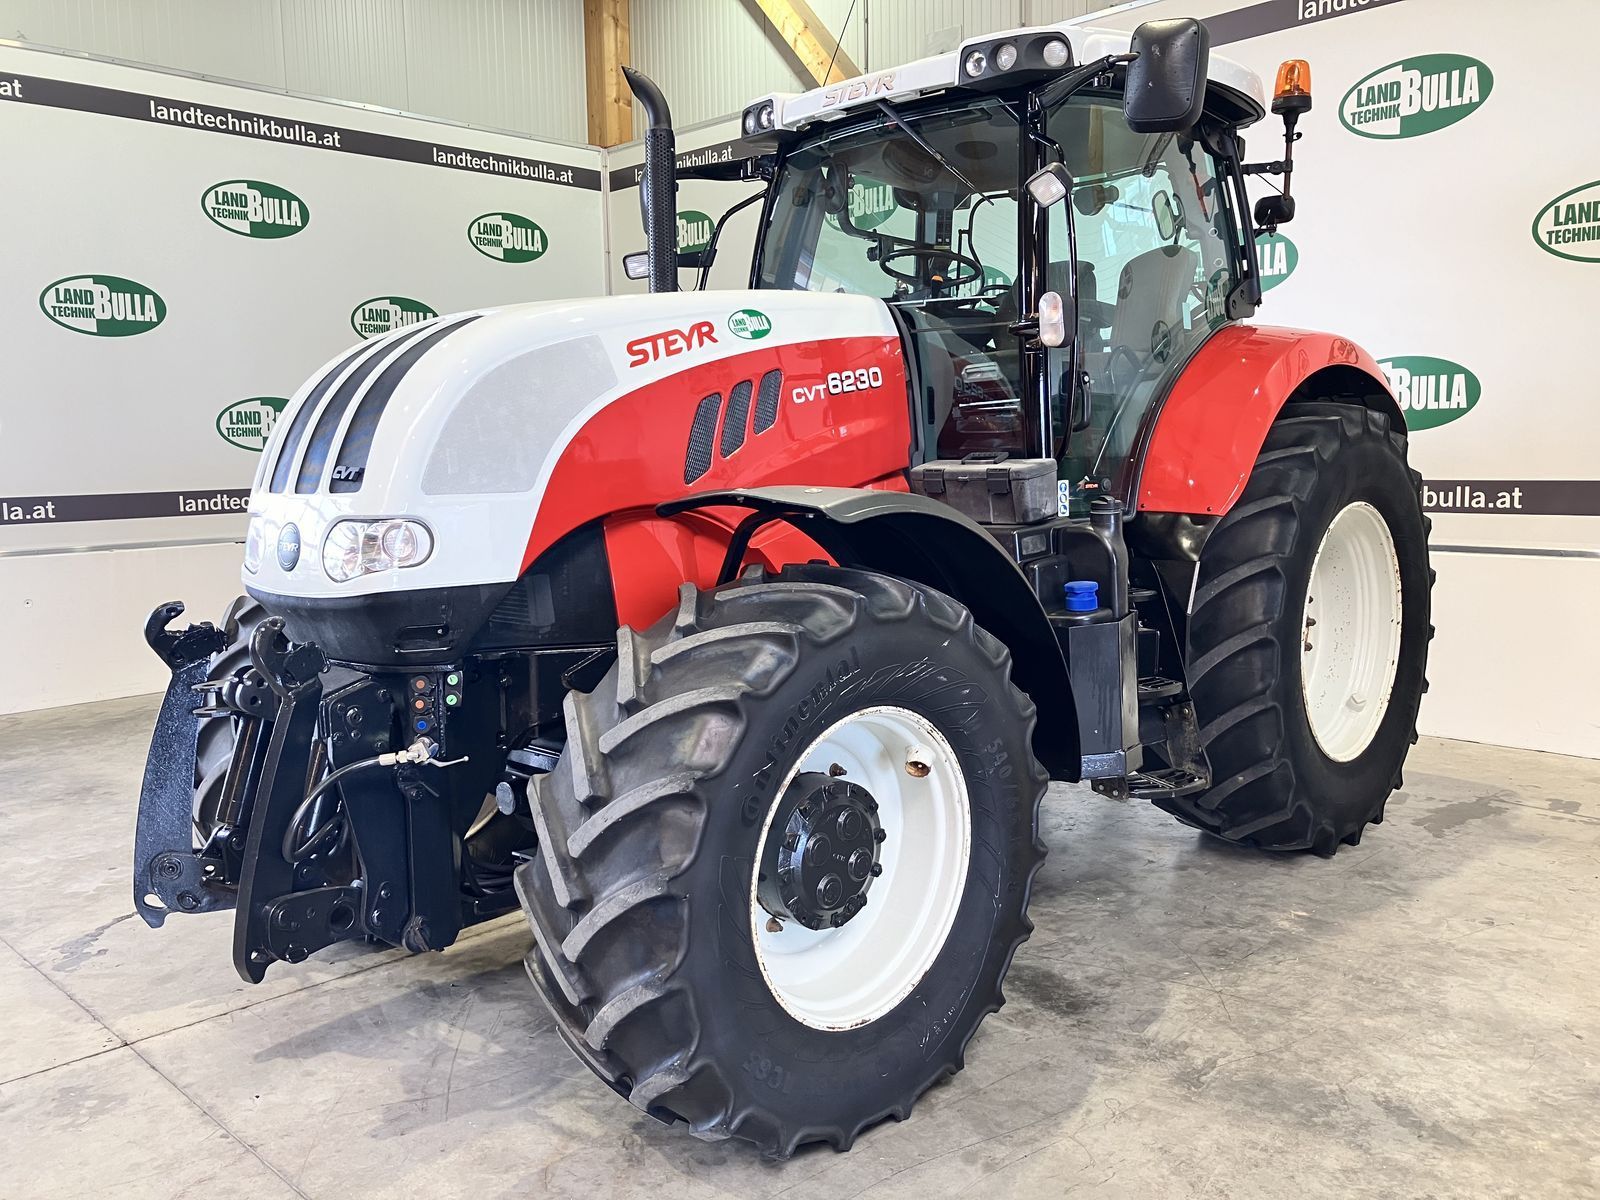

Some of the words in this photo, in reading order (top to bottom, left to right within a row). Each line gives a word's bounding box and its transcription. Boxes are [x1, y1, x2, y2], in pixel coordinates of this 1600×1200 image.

[823, 72, 896, 107] STEYR
[1356, 80, 1401, 108] LAND
[1400, 66, 1480, 117] BULLA
[150, 100, 341, 148] landtechnikbulla.at
[1350, 103, 1401, 126] TECHNIK
[433, 147, 574, 184] landtechnikbulla.at
[211, 206, 250, 221] TECHNIK
[214, 190, 248, 209] LAND
[248, 188, 302, 227] BULLA
[853, 184, 894, 217] BULLA
[474, 235, 503, 248] TECHNIK
[477, 221, 502, 238] LAND
[502, 220, 543, 253] BULLA
[679, 218, 711, 248] BULLA
[1256, 241, 1288, 277] LLA
[55, 287, 94, 307] LAND
[94, 283, 158, 322] BULLA
[51, 305, 96, 319] TECHNIK
[362, 307, 390, 323] LAND
[626, 321, 719, 368] STEYR
[792, 384, 827, 404] CVT
[827, 366, 883, 395] 6230
[1391, 367, 1467, 411] BULLA
[229, 410, 262, 426] LAND
[226, 427, 263, 438] TECHNIK
[332, 466, 360, 481] CVT
[2, 501, 56, 520] la.at
[1421, 485, 1523, 509] bulla.at
